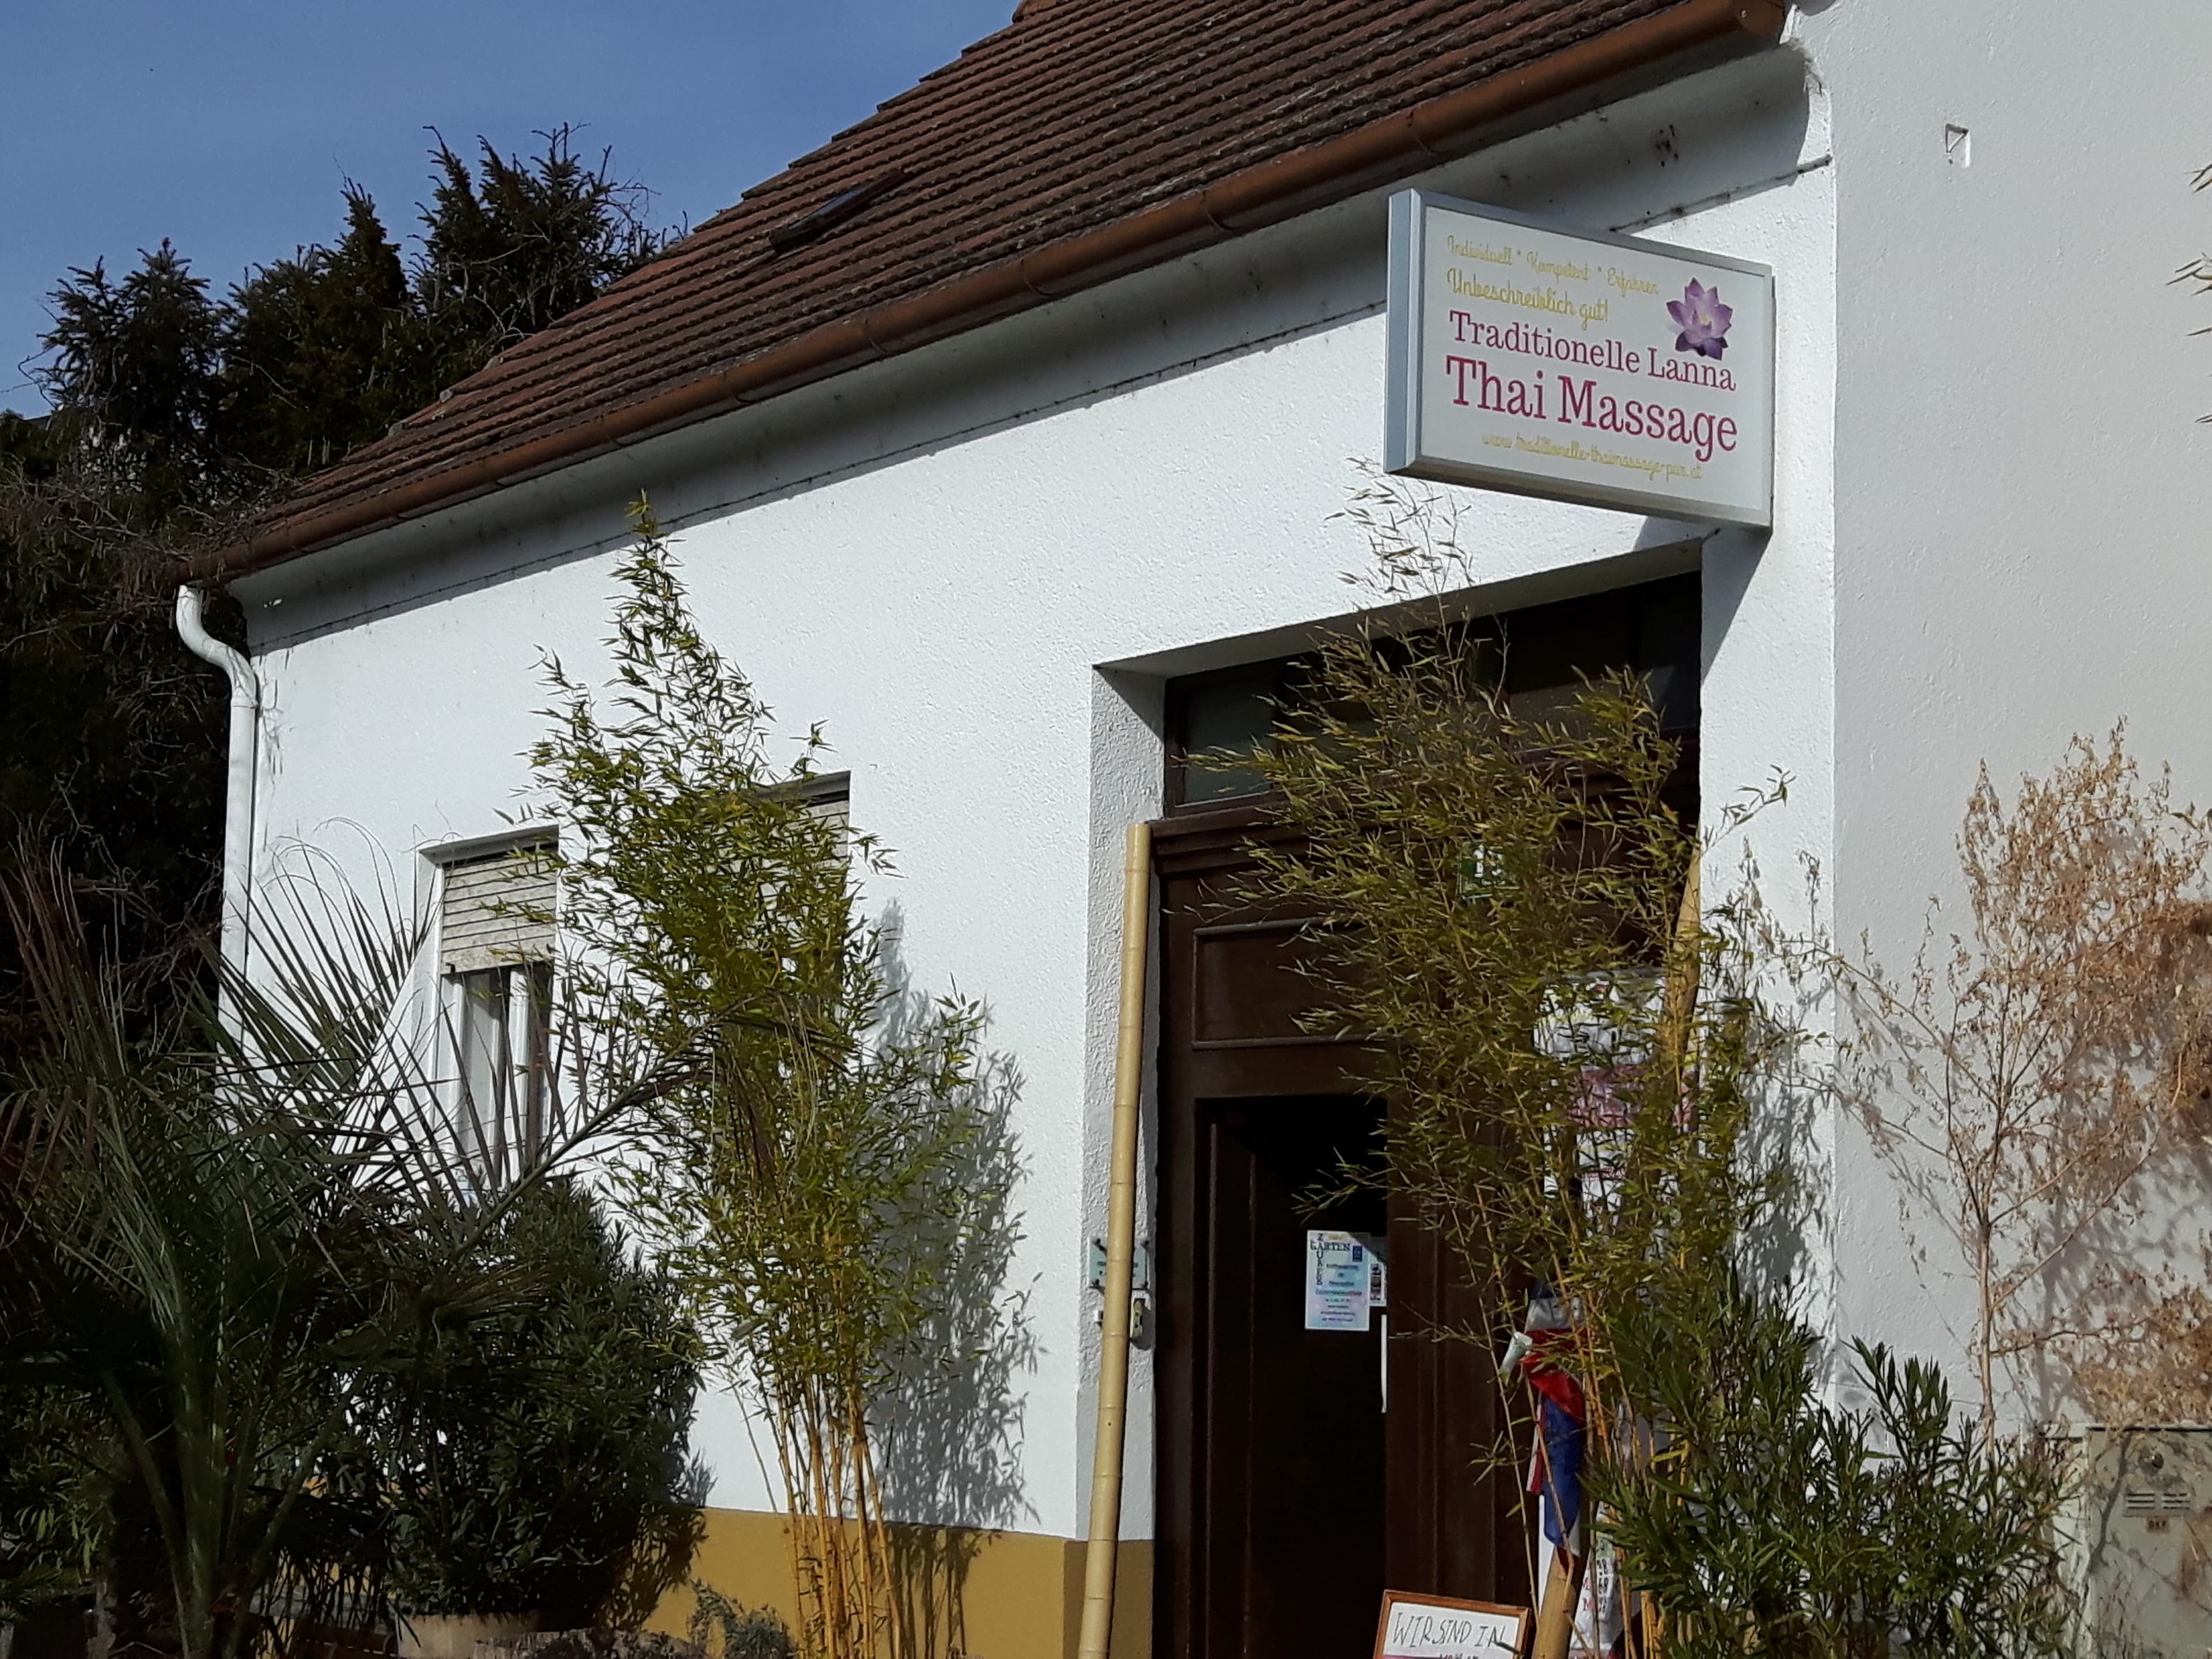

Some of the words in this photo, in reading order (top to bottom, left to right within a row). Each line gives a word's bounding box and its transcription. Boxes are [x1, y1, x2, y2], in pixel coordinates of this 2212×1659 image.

[1447, 235, 1512, 266] Individuell
[1527, 251, 1590, 284] Kompetent
[1447, 268, 1575, 316] Unbeschreiblich
[1579, 297, 1608, 331] gut!
[1449, 309, 1640, 373] Traditionelle
[1647, 347, 1736, 391] Lanna
[1446, 355, 1547, 419] Thai
[1558, 375, 1737, 462] Massage
[1393, 1612, 1433, 1648] WIR
[1432, 1619, 1472, 1645] SIND
